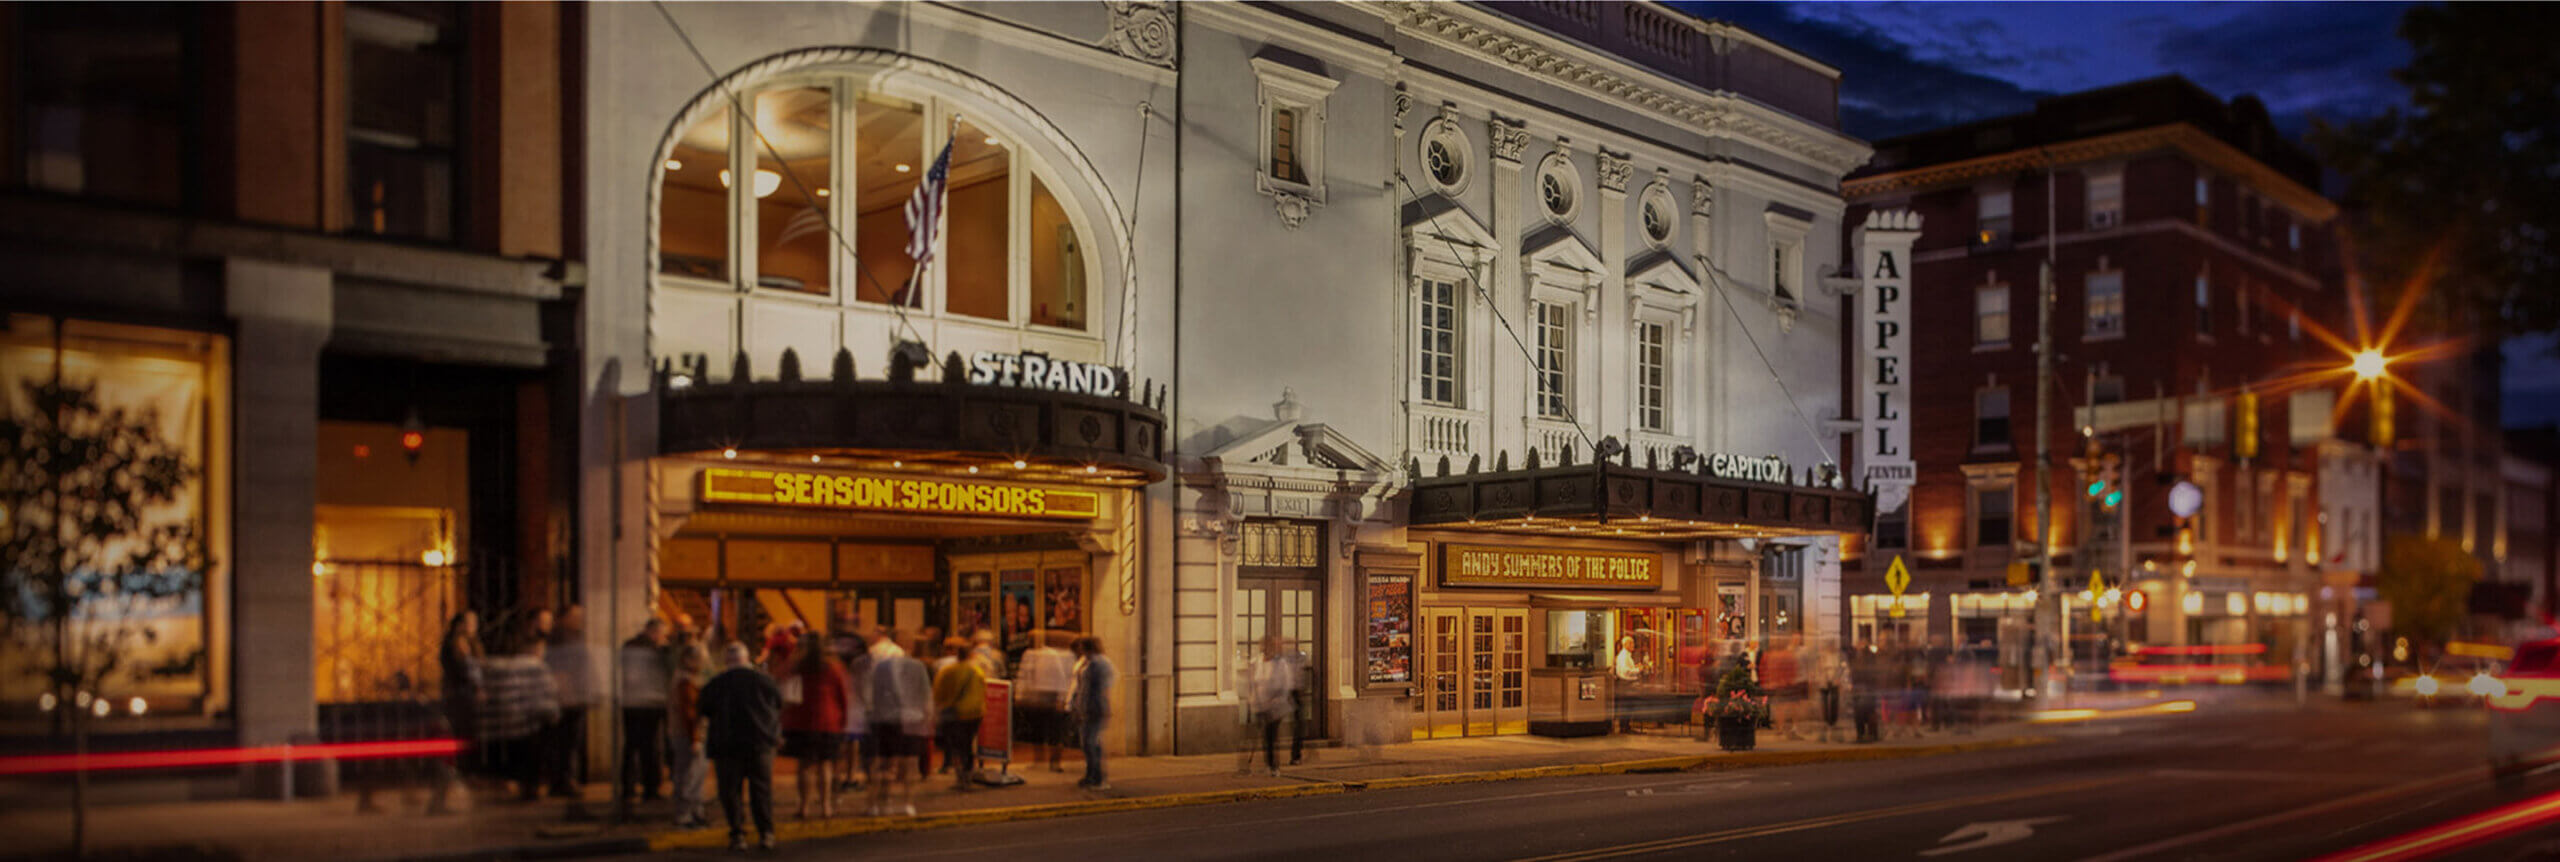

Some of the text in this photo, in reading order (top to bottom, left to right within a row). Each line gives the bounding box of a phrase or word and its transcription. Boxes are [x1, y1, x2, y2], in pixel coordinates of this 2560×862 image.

[1873, 250, 1901, 457] APPELL
[971, 350, 1116, 398] STRAND
[1712, 453, 1787, 484] CAPITOL
[1867, 465, 1913, 480] CENTER
[773, 471, 1046, 516] SEASON SPONSORS
[1274, 496, 1305, 512] EXIT
[1462, 551, 1651, 581] ANDY SUMMERS OF THE POLICE
